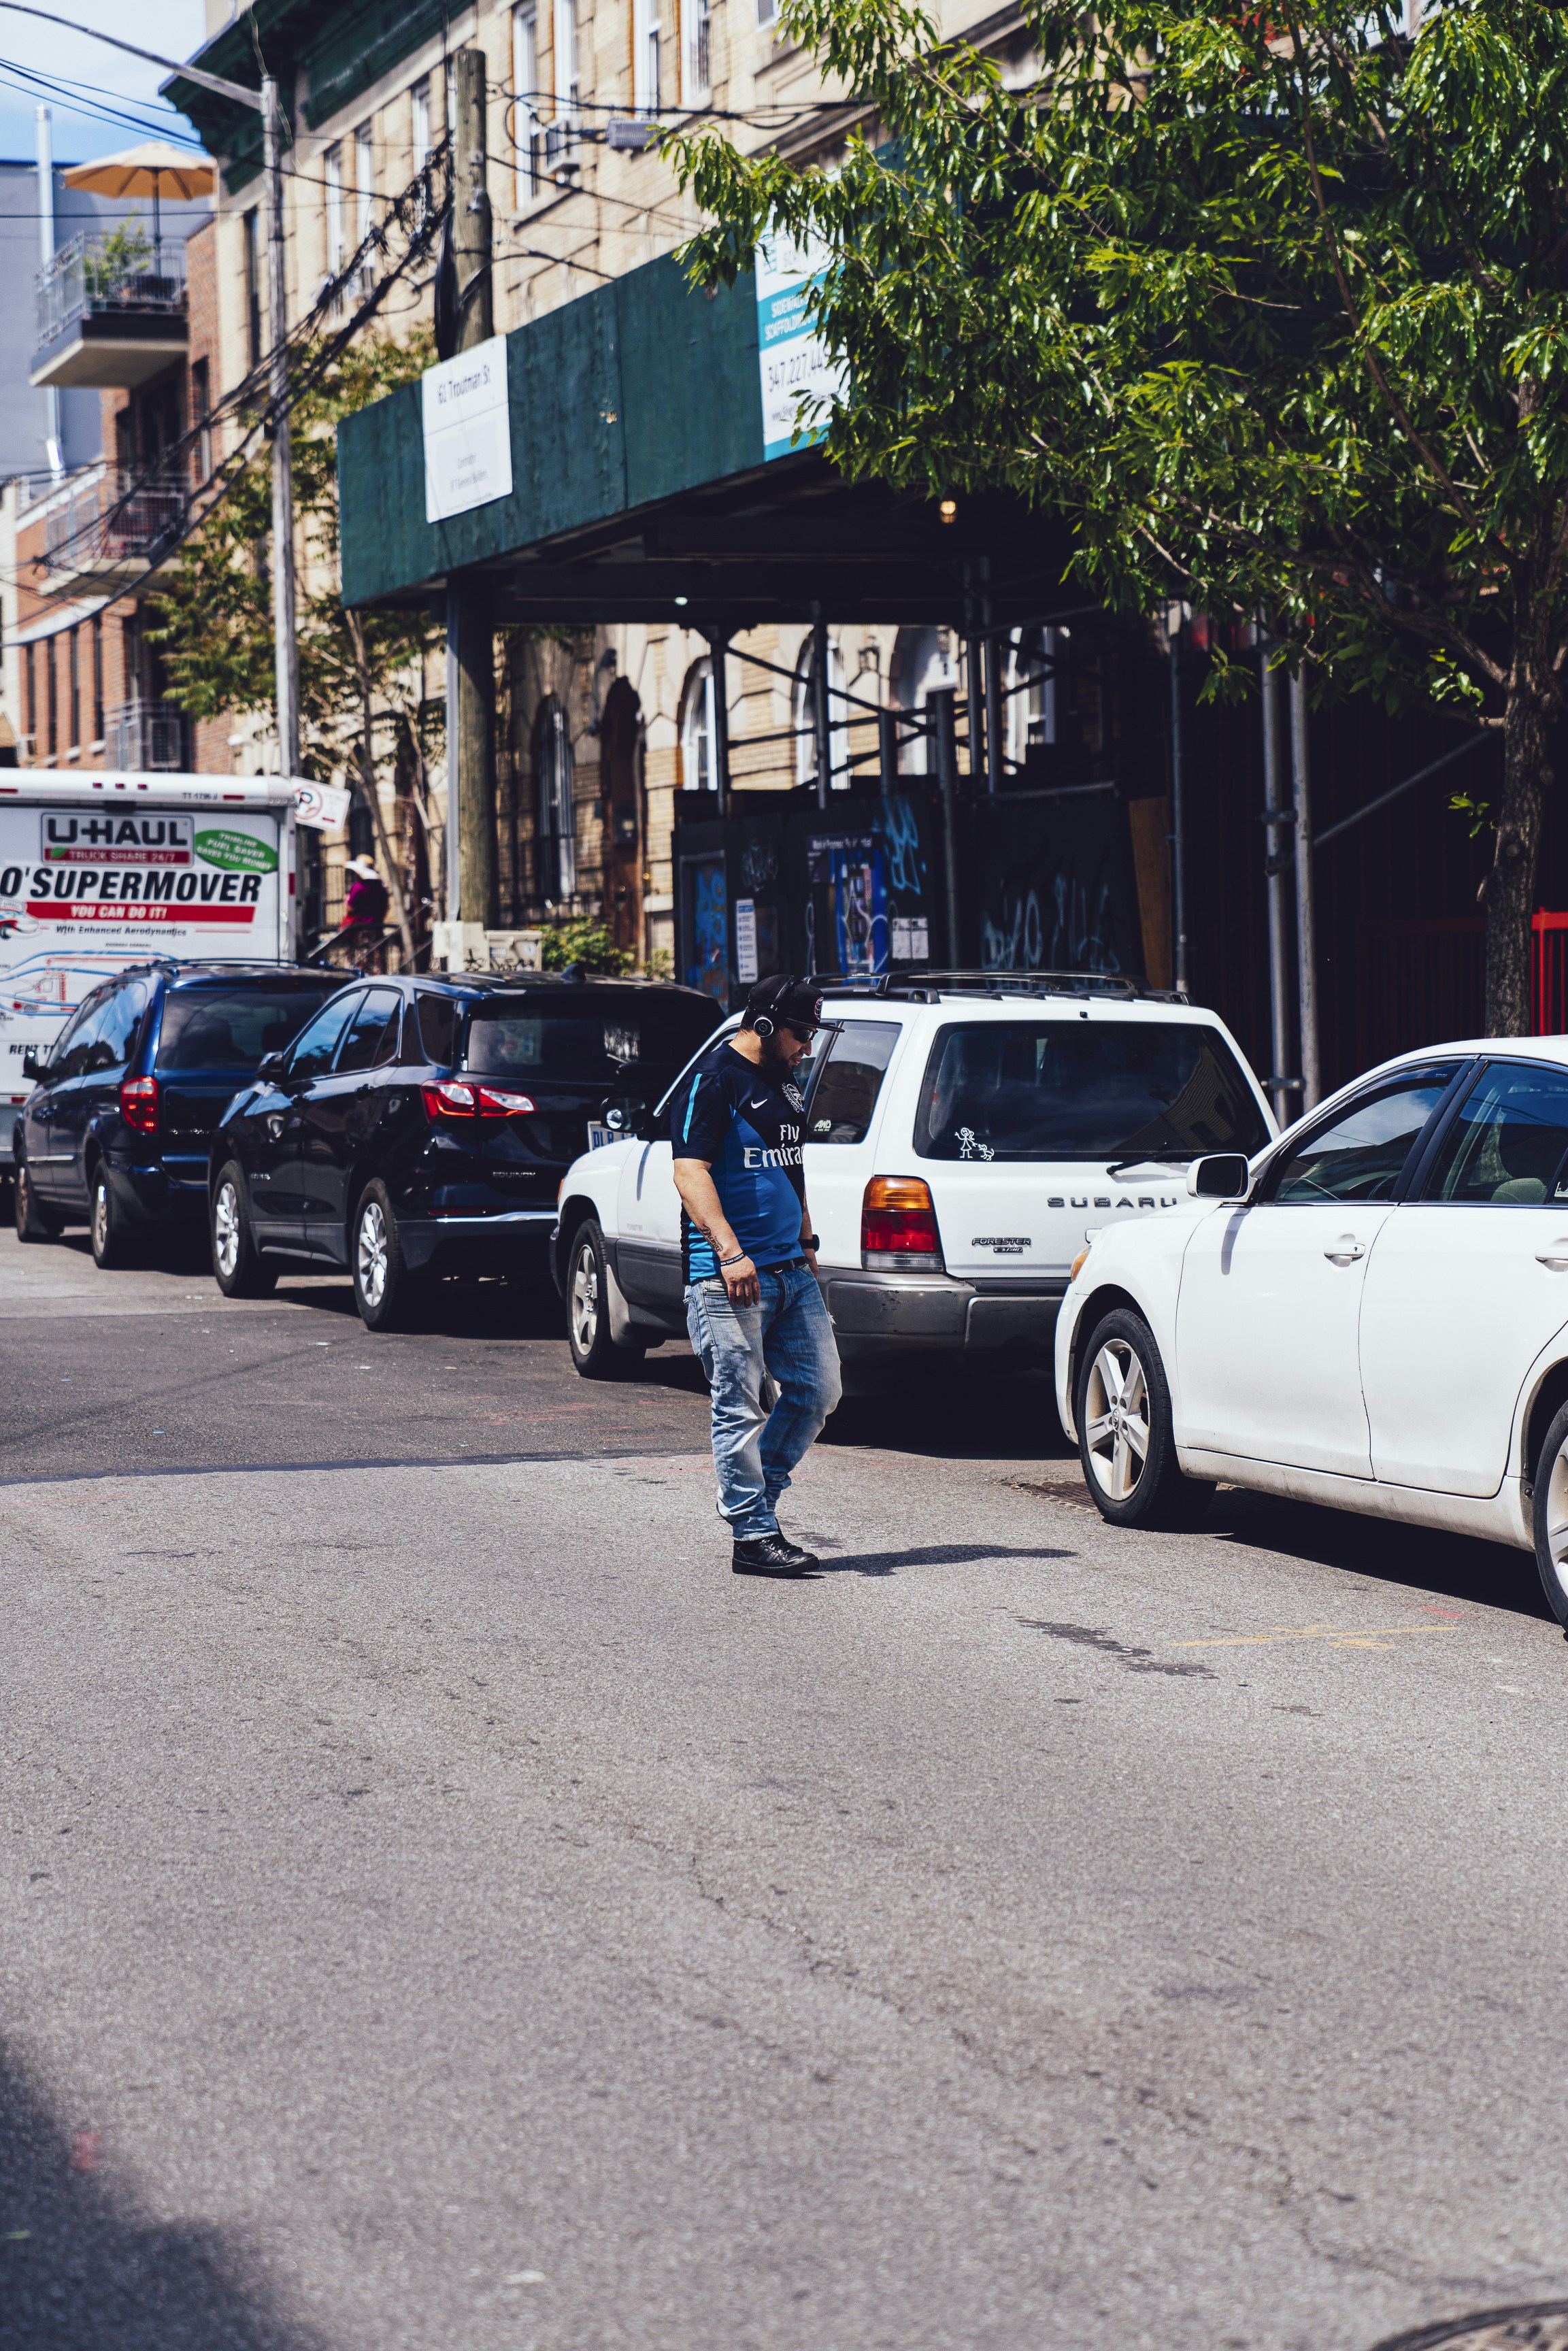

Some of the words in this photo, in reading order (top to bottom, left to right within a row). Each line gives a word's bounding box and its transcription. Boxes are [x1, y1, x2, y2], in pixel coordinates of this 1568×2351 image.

[448, 373, 482, 401] Troutman
[207, 839, 231, 851] FUEL
[234, 846, 265, 858] SAVER
[197, 846, 222, 858] SAVES
[224, 852, 241, 863] YOU
[241, 857, 272, 870] MONEY
[70, 904, 96, 918] YOU
[99, 905, 126, 918] CAN
[128, 905, 146, 919] DO
[149, 906, 167, 920] IT!
[56, 924, 76, 935] With
[78, 926, 122, 935] Enhanced
[124, 927, 187, 937] Aerodynamics
[814, 1120, 831, 1129] AWD
[780, 1124, 800, 1143] Fly
[1047, 1197, 1178, 1208] SUBARU
[972, 1237, 1031, 1246] FORESTER
